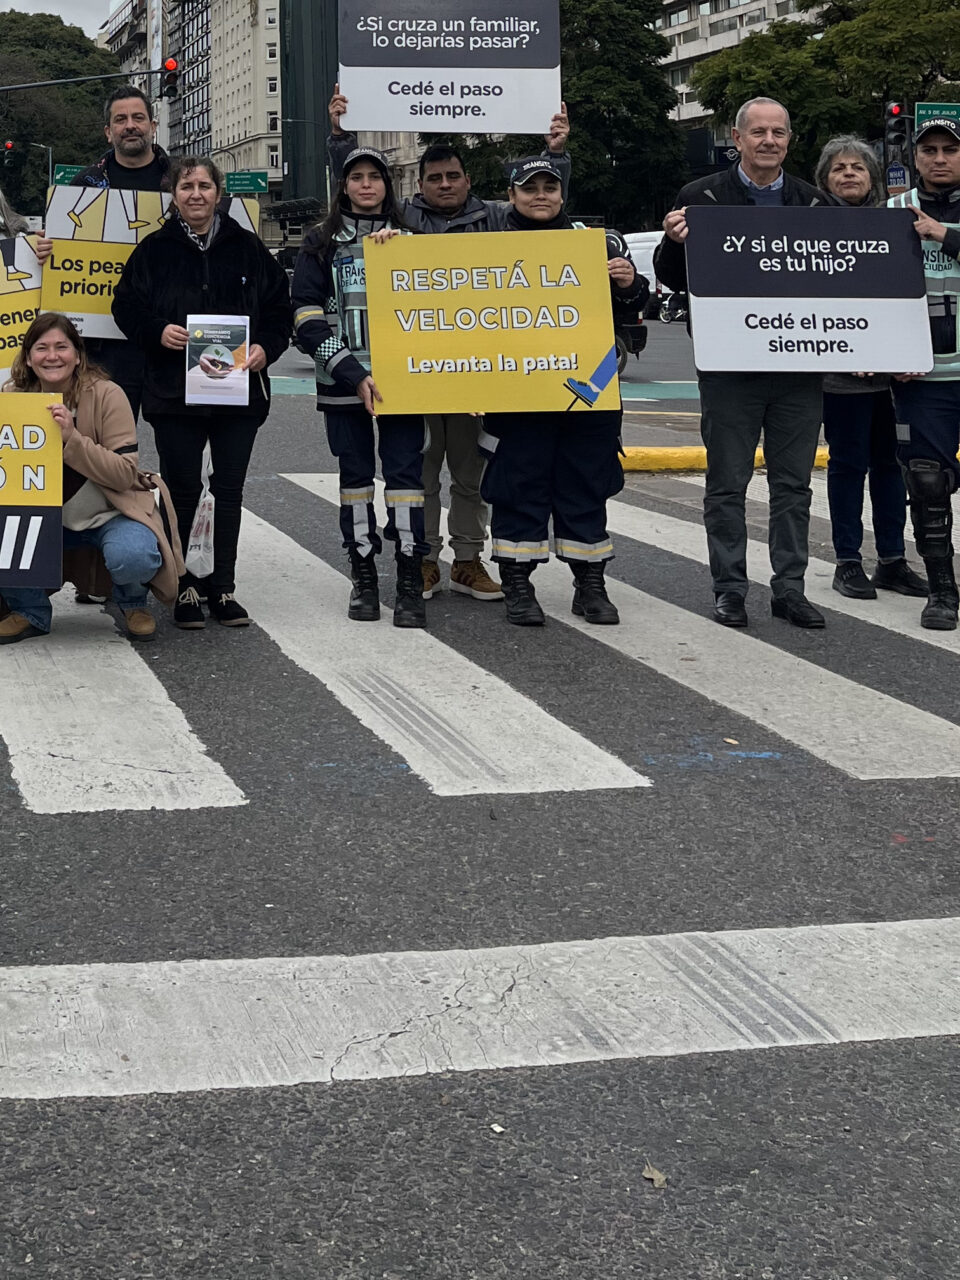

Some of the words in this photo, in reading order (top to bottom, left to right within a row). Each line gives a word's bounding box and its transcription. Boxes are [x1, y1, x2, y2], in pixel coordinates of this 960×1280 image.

[357, 16, 382, 32] ¿Si
[387, 19, 437, 32] cruza
[442, 19, 465, 32] un
[470, 17, 540, 34] familiar,
[372, 32, 389, 48] lo
[394, 33, 465, 50] dejarías
[469, 34, 530, 50] pasar?
[388, 81, 434, 96] Cedé
[439, 82, 454, 96] el
[460, 84, 503, 98] paso
[409, 101, 486, 118] siempre.
[922, 119, 956, 129] TRANSITO
[723, 236, 746, 253] ¿Y
[751, 236, 766, 253] si
[771, 236, 788, 253] el
[793, 239, 831, 256] que
[836, 240, 890, 254] cruza
[50, 254, 84, 272] Los
[759, 258, 781, 272] es
[786, 256, 806, 272] tu
[811, 255, 857, 275] hijo?
[924, 263, 953, 272] CIUDAD
[391, 259, 530, 292] RESPETÁ
[540, 264, 581, 288] LA
[60, 278, 115, 297] priori
[394, 305, 580, 332] VELOCIDAD
[744, 312, 795, 330] Cedé
[800, 313, 817, 330] el
[823, 317, 869, 333] paso
[768, 336, 854, 356] siempre.
[407, 356, 493, 375] Levanta
[498, 353, 518, 372] la
[523, 352, 578, 375] pata!
